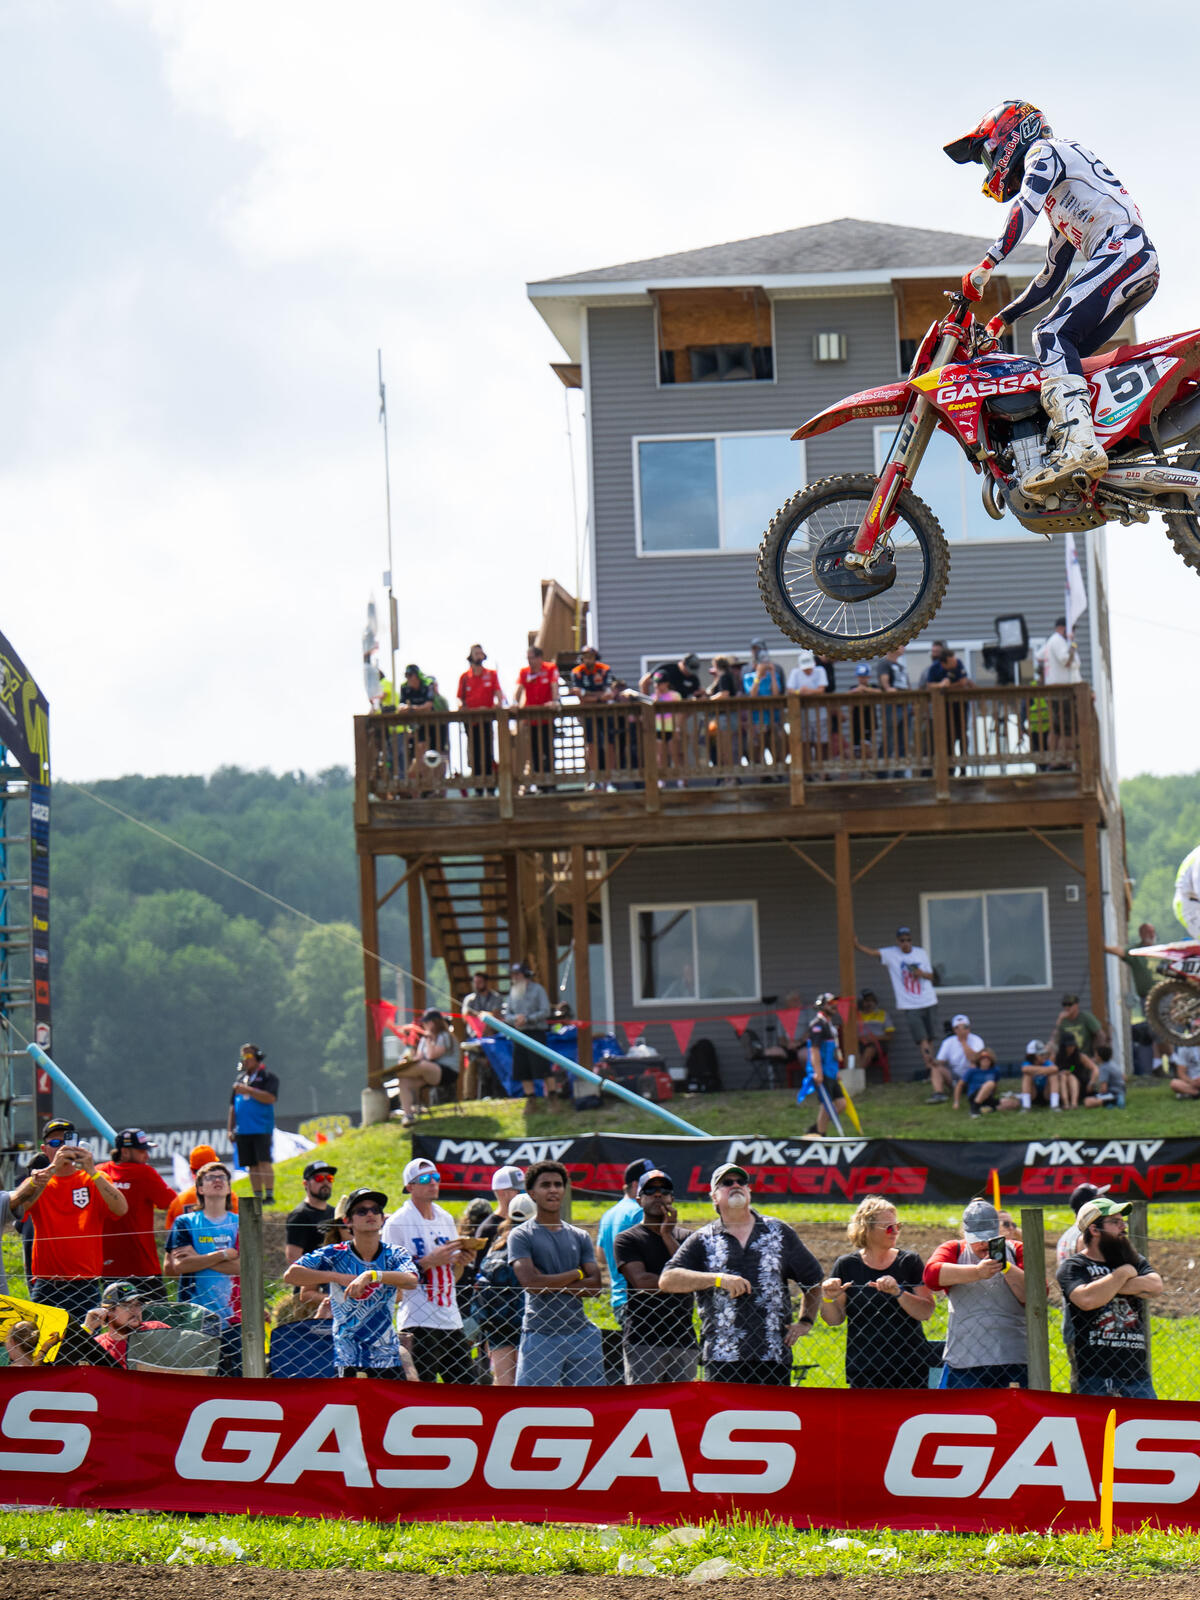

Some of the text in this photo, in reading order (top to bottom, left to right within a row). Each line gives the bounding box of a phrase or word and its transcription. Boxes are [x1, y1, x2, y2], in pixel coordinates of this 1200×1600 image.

[998, 131, 1021, 168] Red Bull
[1101, 255, 1142, 297] GASGAS
[687, 1166, 928, 1200] LGENDS
[174, 1398, 802, 1495] GASGAS
